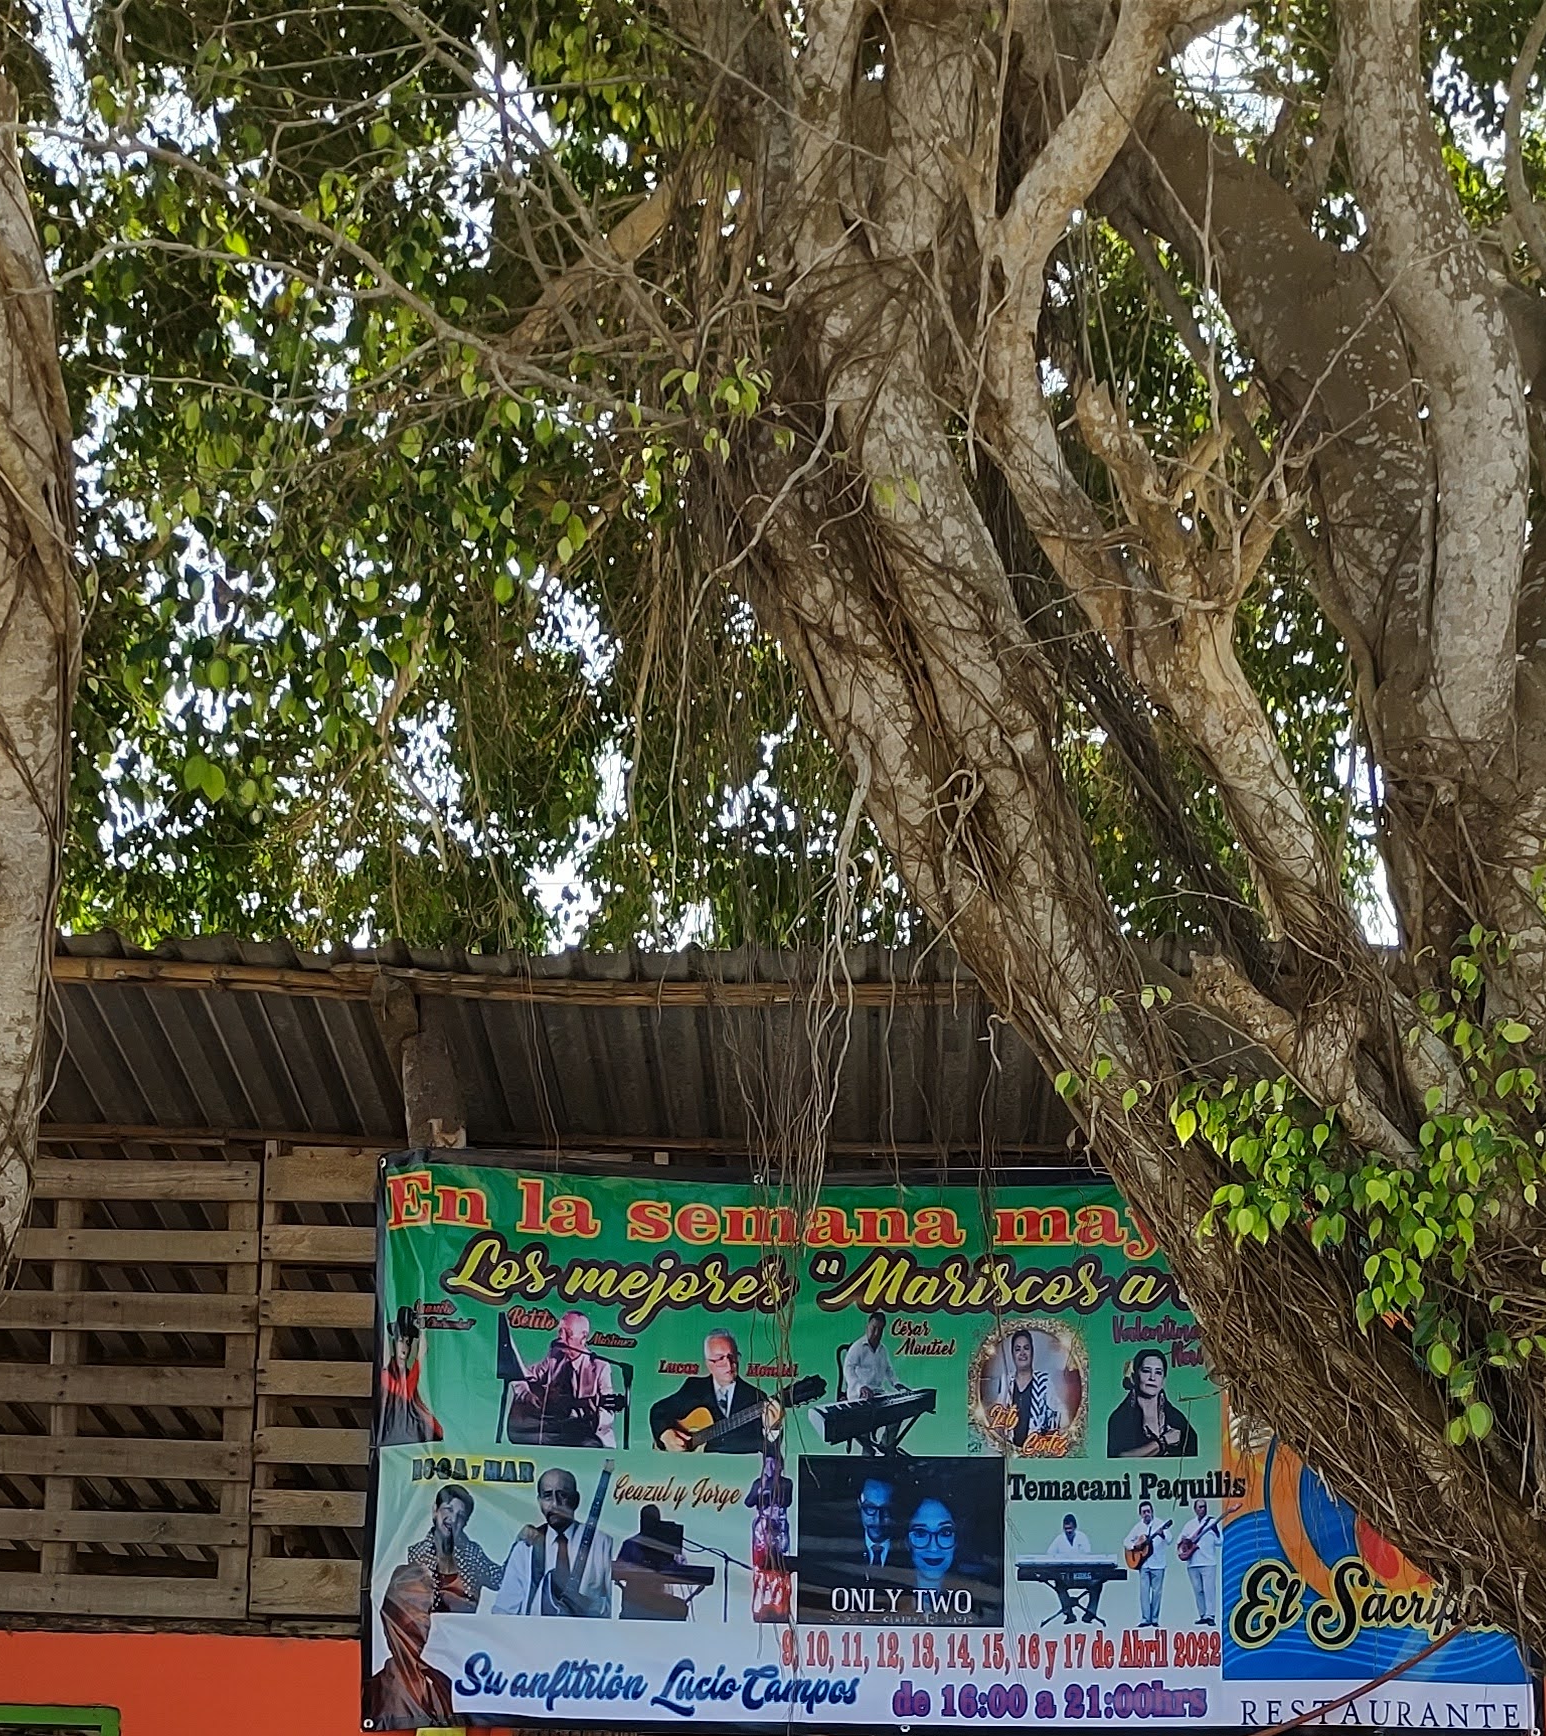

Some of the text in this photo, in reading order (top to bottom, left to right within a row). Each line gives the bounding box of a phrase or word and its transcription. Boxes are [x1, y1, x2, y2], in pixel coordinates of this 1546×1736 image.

[387, 1171, 1161, 1260] En la semana may
[446, 1238, 1168, 1326] Los mejores "Mariscos a
[891, 1318, 931, 1337] César
[895, 1339, 956, 1357] Montiel
[657, 1359, 700, 1375] Lucas
[613, 1475, 742, 1512] Geazul y Jorge
[1007, 1470, 1247, 1507] Temacani Paquilis
[830, 1586, 973, 1615] ONLY TWO
[1231, 1562, 1302, 1646] El
[806, 1630, 834, 1674] 10,
[841, 1631, 870, 1675] 11,
[876, 1631, 905, 1675] 12,
[912, 1631, 940, 1676] 13,
[947, 1632, 975, 1676] 14,
[982, 1632, 1011, 1676] 15,
[1017, 1632, 1041, 1669] 16
[1044, 1640, 1058, 1680] y
[1063, 1633, 1087, 1669] 17
[1091, 1629, 1115, 1669] de
[1118, 1629, 1169, 1669] Abril
[1173, 1631, 1222, 1668] 2022
[454, 1651, 862, 1717] Su anfitrión Lucio Campos
[892, 1679, 1208, 1719] de 16:00 a 21:00hrs
[1240, 1698, 1521, 1729] RESTAURANTE
